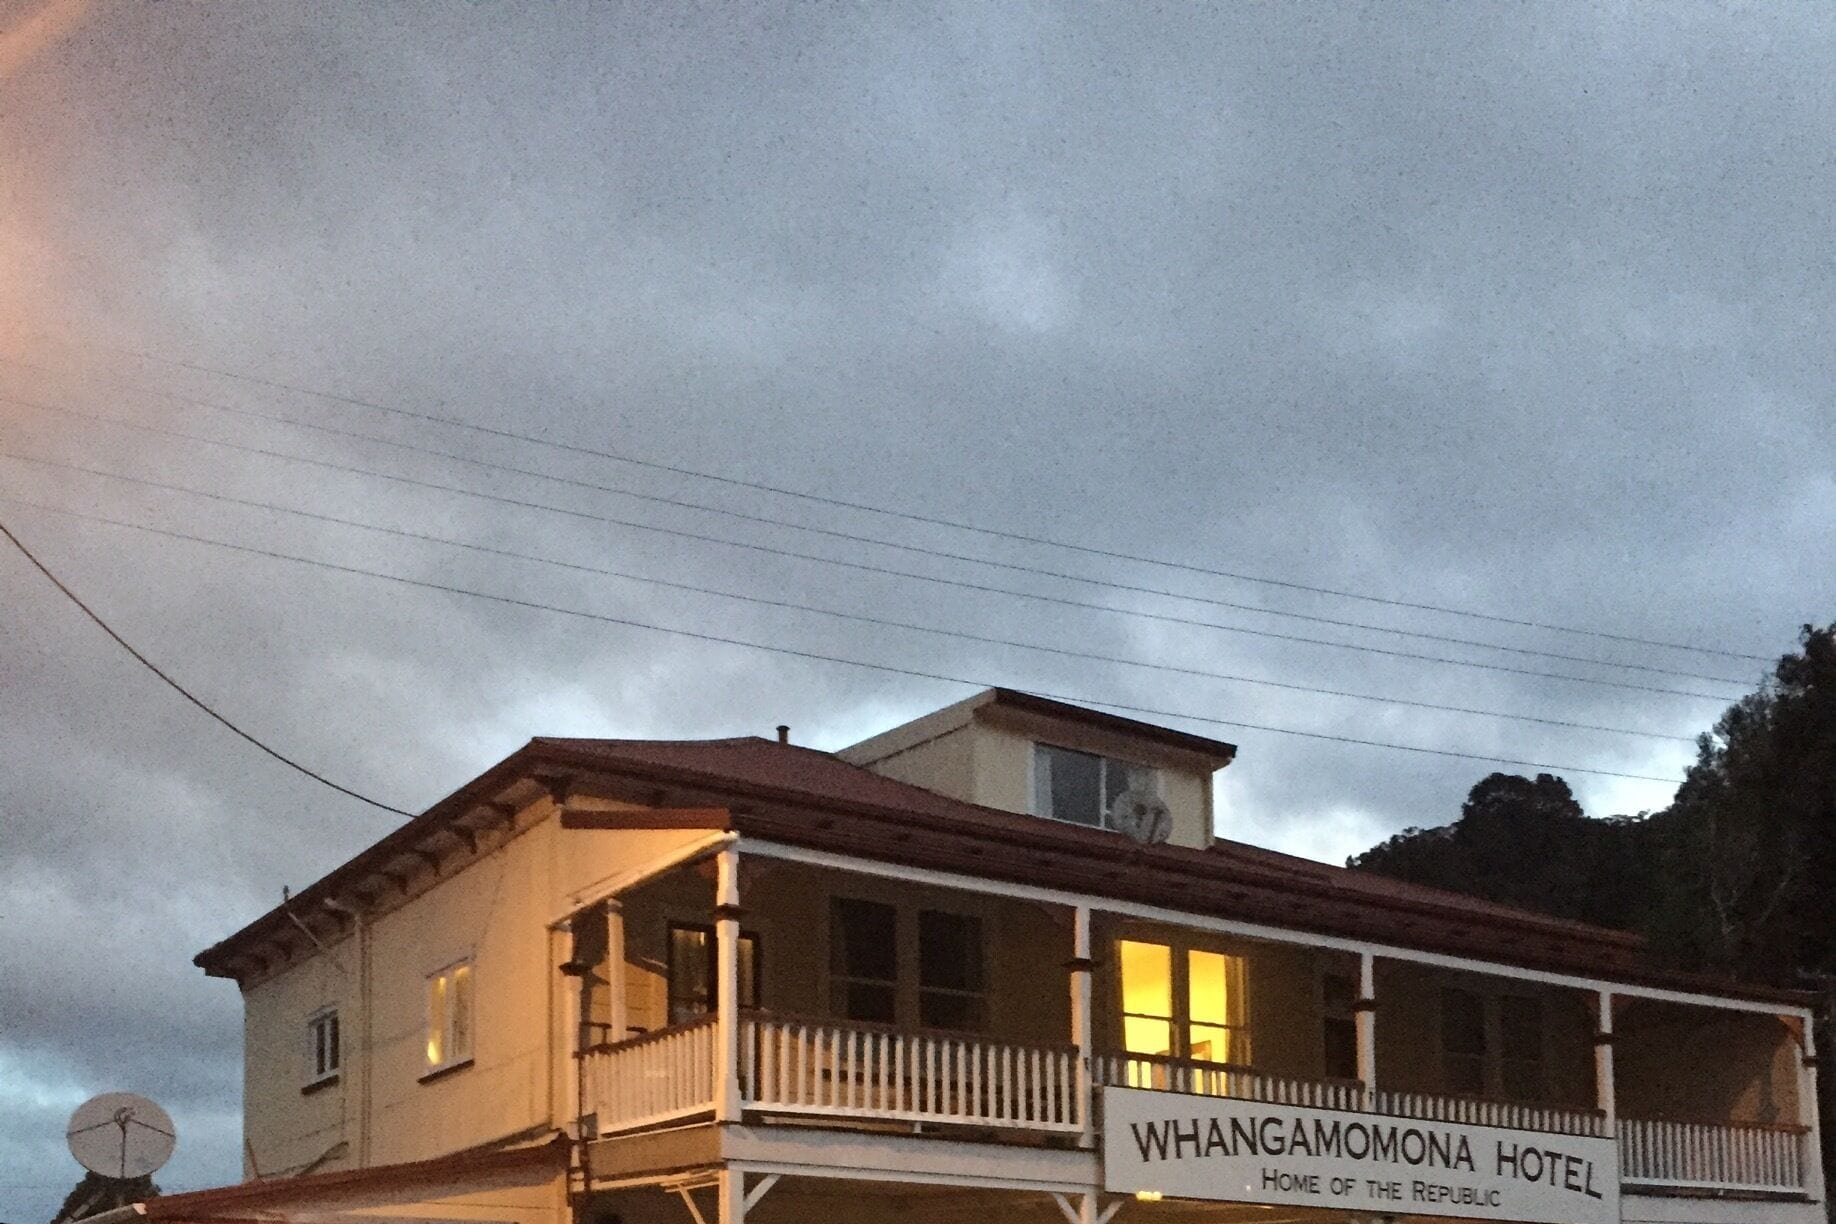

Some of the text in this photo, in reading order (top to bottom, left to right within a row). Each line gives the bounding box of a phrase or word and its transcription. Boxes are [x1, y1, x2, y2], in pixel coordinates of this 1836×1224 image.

[1131, 1116, 1602, 1200] WHANGAMOMONA HOTEL
[1330, 1177, 1356, 1196] OF
[1366, 1179, 1402, 1200] THE
